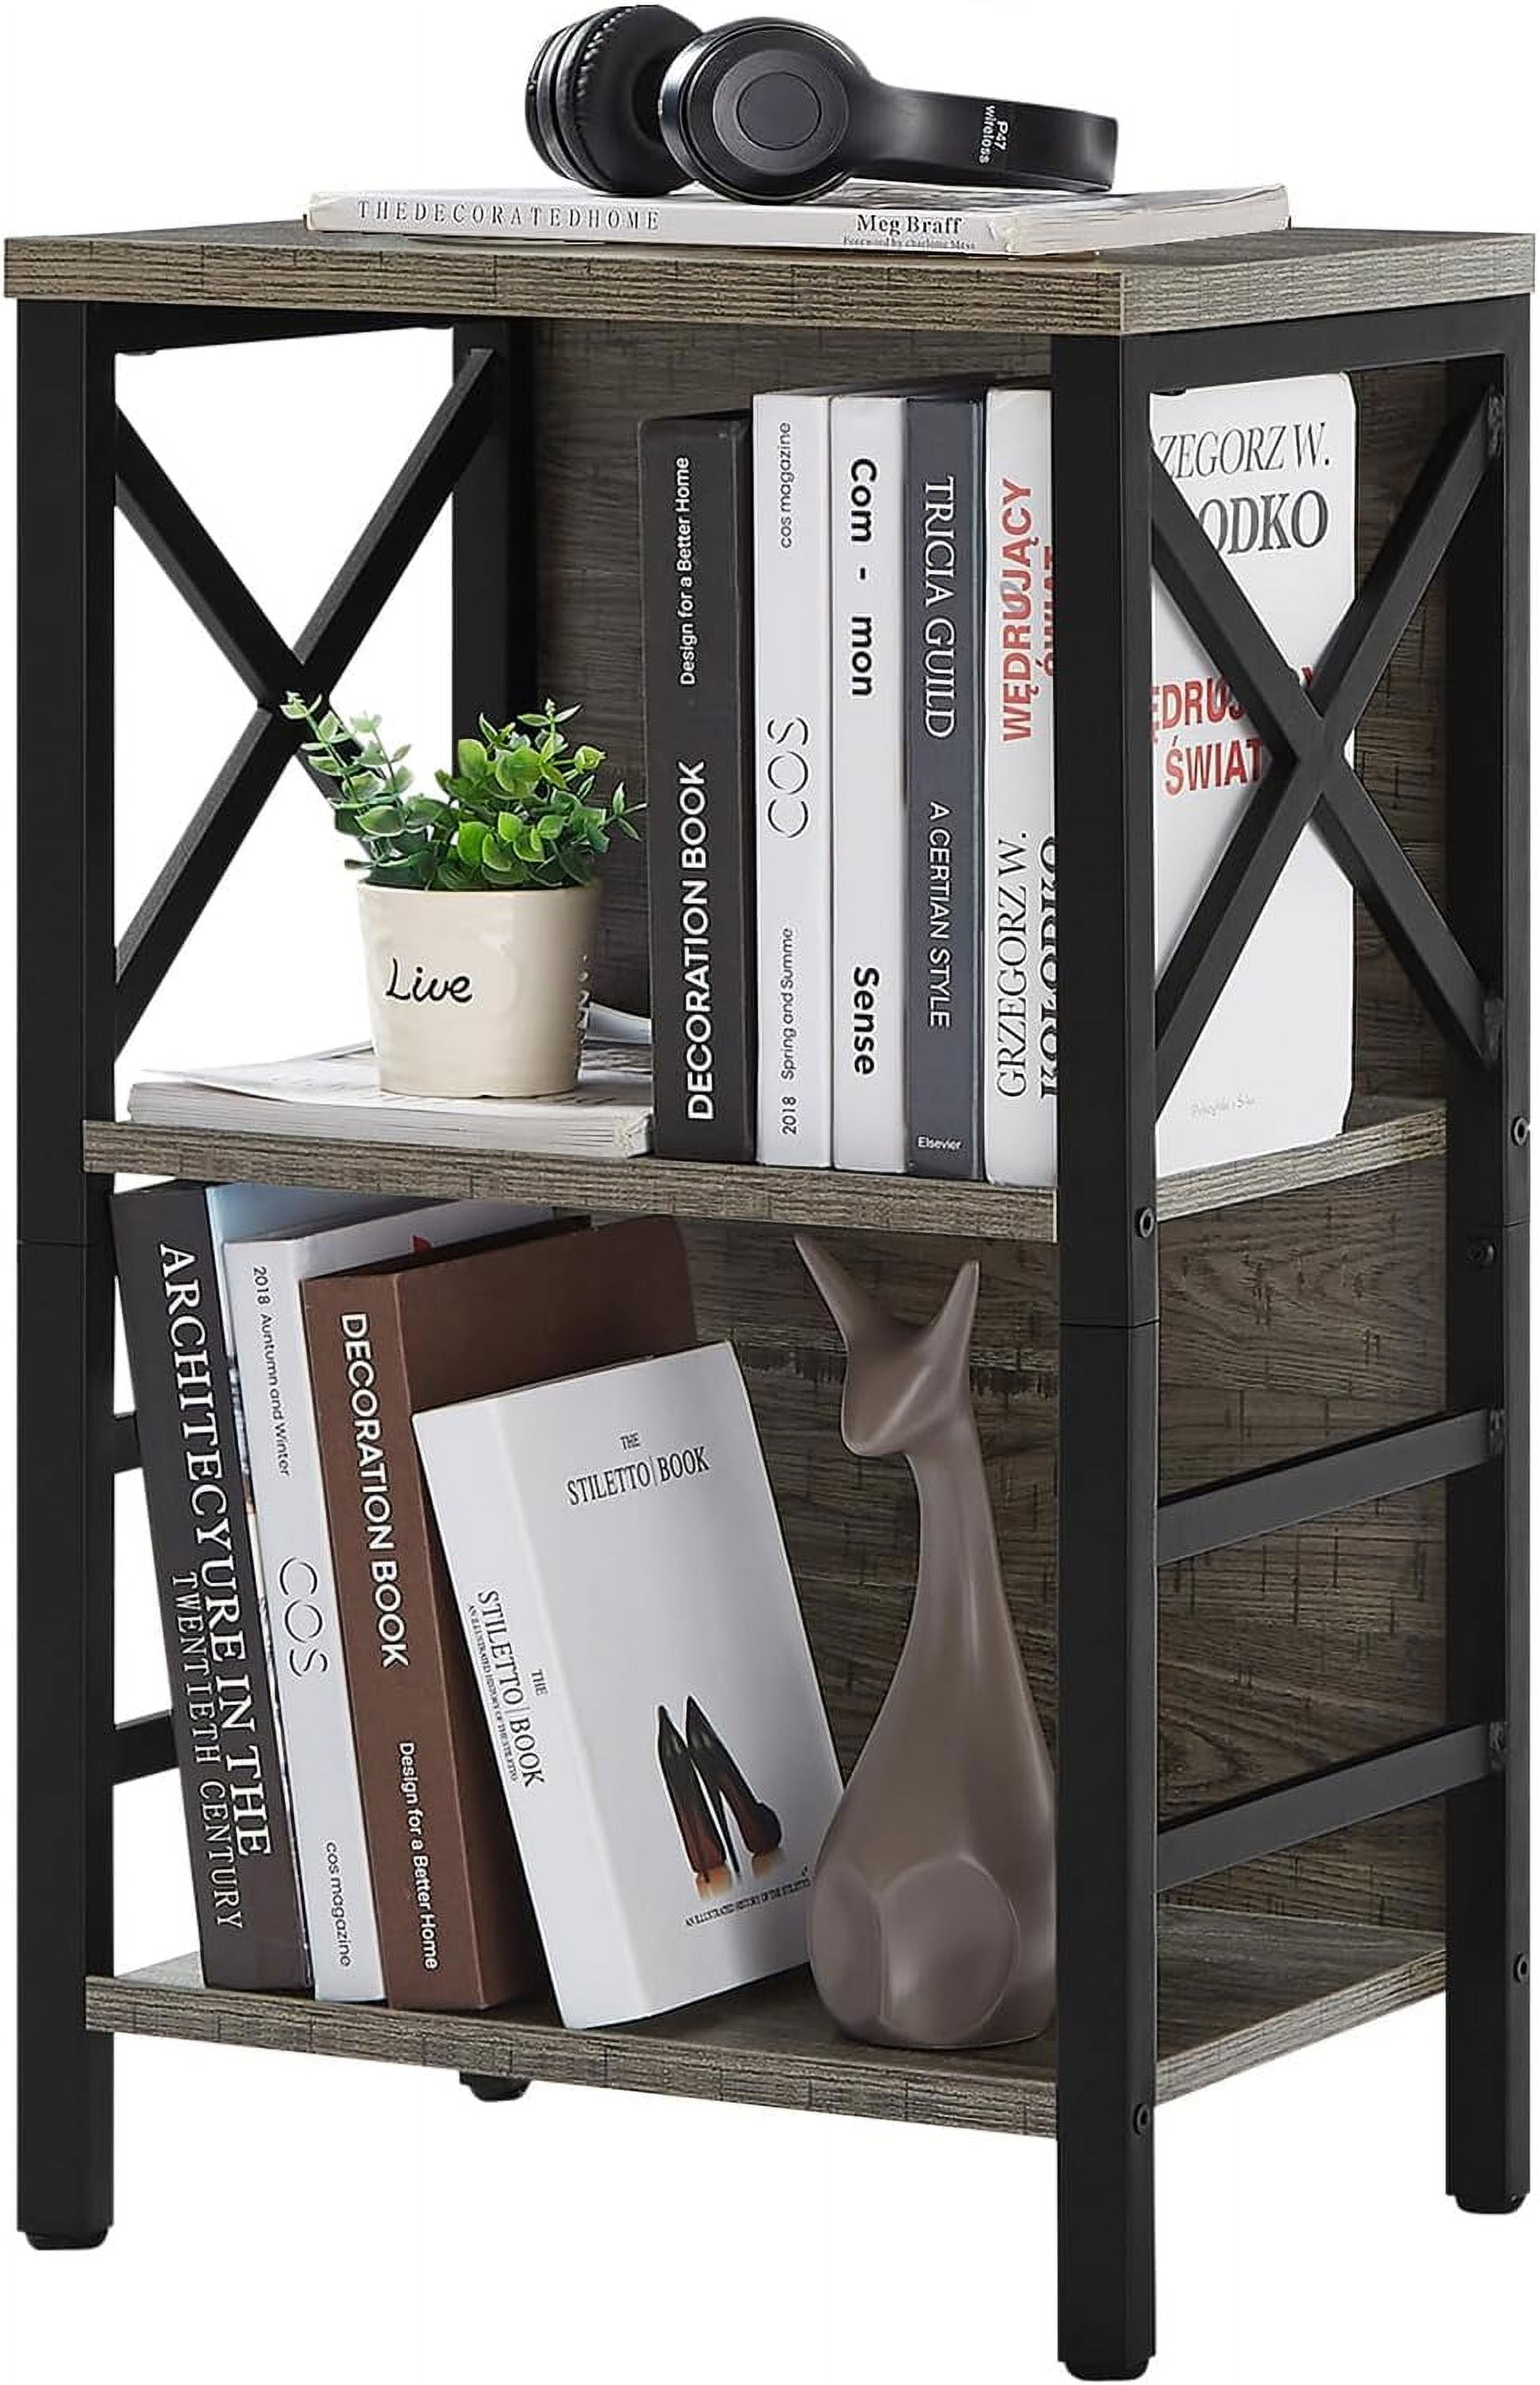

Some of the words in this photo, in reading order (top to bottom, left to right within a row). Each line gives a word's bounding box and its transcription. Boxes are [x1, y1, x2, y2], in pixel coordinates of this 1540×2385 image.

[857, 214, 901, 236] Meg
[907, 216, 962, 234] Braff
[780, 422, 794, 513] magazine
[1294, 422, 1329, 468] W.
[675, 457, 690, 512] Home
[851, 458, 877, 542] Com
[676, 517, 693, 573] Better
[780, 517, 792, 548] cos
[925, 476, 955, 607] TRICIA
[678, 591, 693, 619] for
[681, 576, 692, 587] a
[1002, 479, 1039, 741] WĘDRUJĄCY
[679, 627, 697, 686] Design
[852, 617, 872, 696] mon
[925, 618, 955, 738] GUILD
[767, 717, 809, 837] COS
[1166, 735, 1262, 795] ŚWIAT
[678, 761, 707, 869] BOOK
[930, 802, 949, 819] A
[998, 832, 1027, 875] W.
[929, 829, 950, 939] CERTIAN
[386, 957, 473, 1003] Live
[683, 881, 714, 1119] DECORATION
[781, 992, 793, 1024] and
[929, 949, 949, 1027] STYLE
[996, 886, 1027, 1097] GRZEGORZ
[854, 967, 878, 1075] Sense
[780, 1027, 796, 1080] Spring
[782, 1096, 796, 1134] 2018
[253, 1266, 271, 1305] 2018
[269, 1389, 284, 1420] and
[160, 1244, 248, 1663] ARCHITECYURE
[274, 1422, 290, 1476] Winter
[620, 1433, 640, 1450] THE
[341, 1313, 398, 1551] DECORATION
[371, 1560, 409, 1669] BOOK
[568, 1462, 650, 1505] STILETTO
[658, 1446, 709, 1482] BOOK
[280, 1557, 328, 1676] COS
[216, 1675, 256, 1732] IN
[478, 1591, 523, 1704] STILETTO
[509, 1717, 544, 1786] BOOK
[532, 1669, 548, 1696] THE
[226, 1746, 272, 1856] THE
[399, 1742, 418, 1805] Design
[407, 1808, 422, 1836] for
[411, 1839, 423, 1850] a
[199, 1782, 243, 1928] CENTURY
[326, 1842, 340, 1874] cos
[413, 1856, 431, 1911] Better
[331, 1877, 352, 1967] magazine
[420, 1914, 438, 1969] Home
